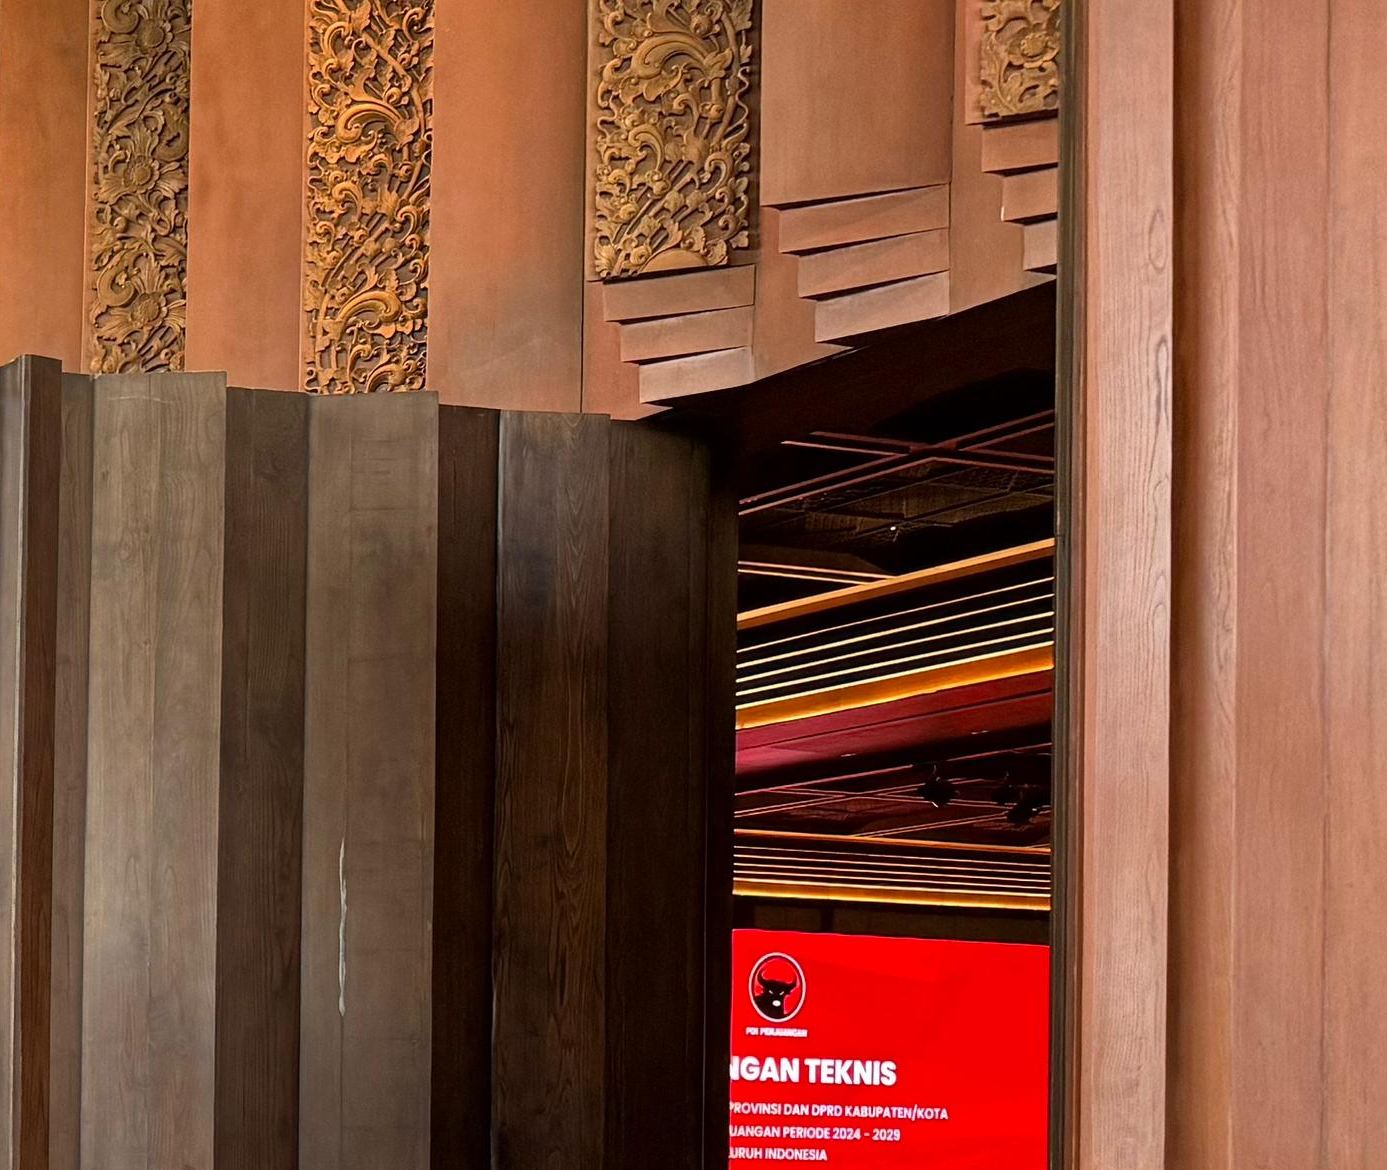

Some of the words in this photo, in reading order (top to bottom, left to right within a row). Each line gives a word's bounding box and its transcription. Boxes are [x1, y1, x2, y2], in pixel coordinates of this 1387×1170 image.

[804, 1058, 897, 1086] TEKNIS
[783, 1104, 809, 1116] DAN
[811, 1104, 842, 1117] DPRD
[844, 1104, 948, 1121] KABUPATEN/KOTA
[782, 1125, 831, 1139] PERIODE
[832, 1127, 861, 1140] 2024
[872, 1128, 900, 1141] 2029
[764, 1148, 827, 1161] INDONESIA
